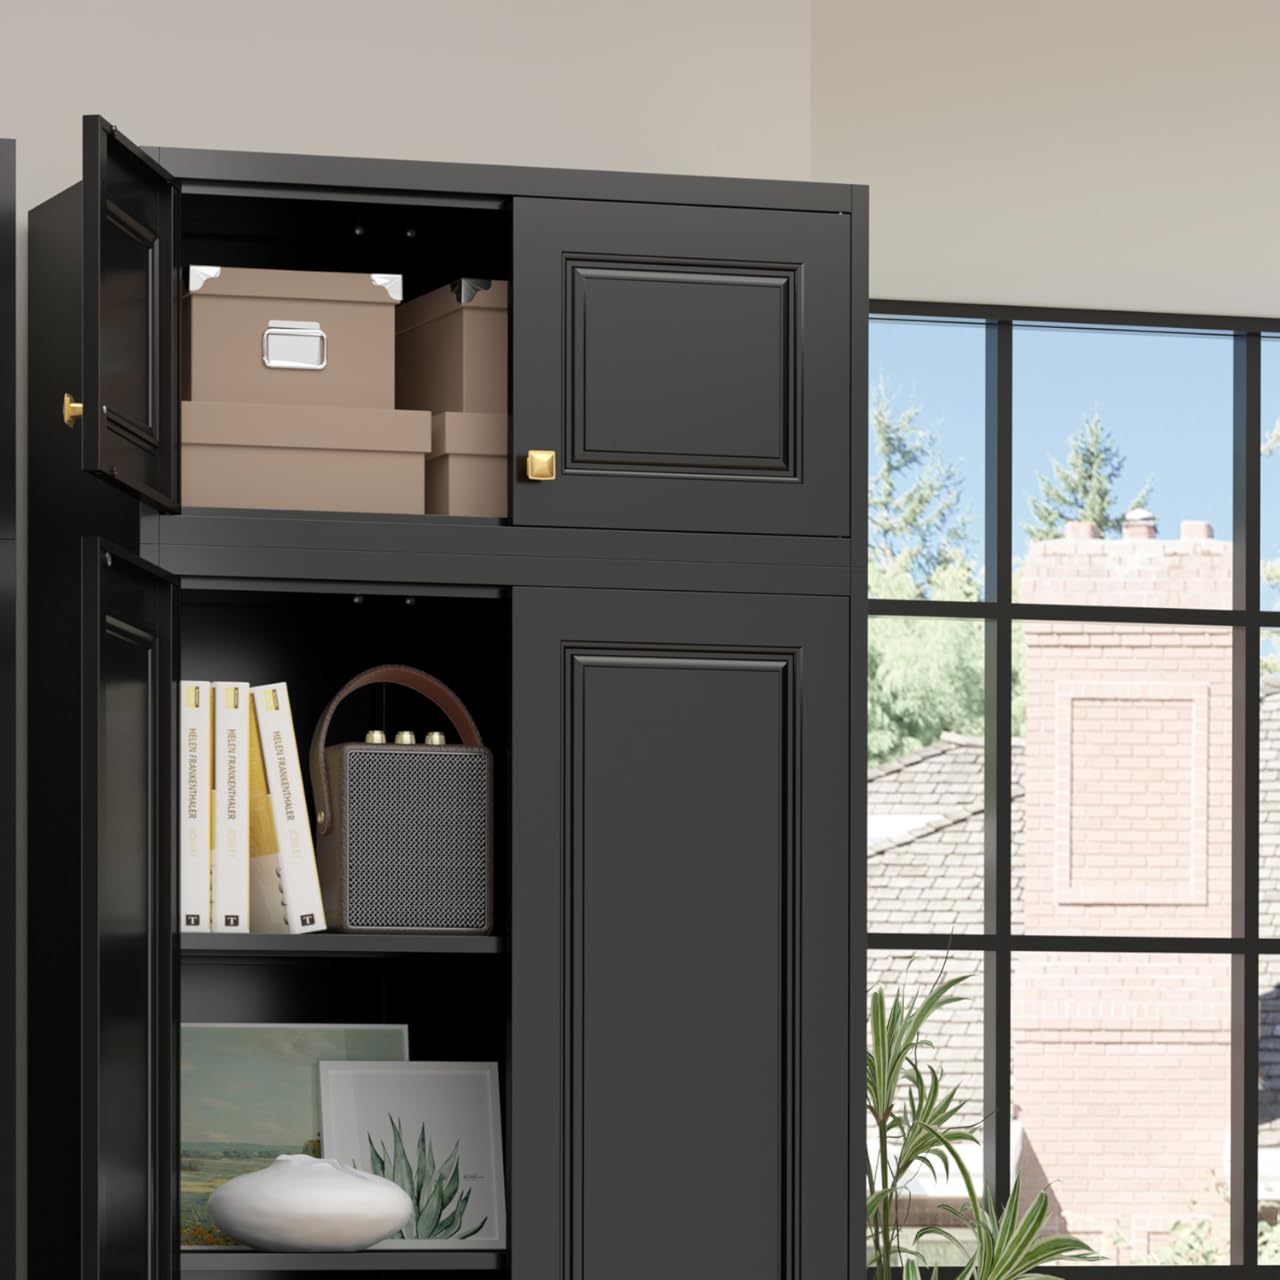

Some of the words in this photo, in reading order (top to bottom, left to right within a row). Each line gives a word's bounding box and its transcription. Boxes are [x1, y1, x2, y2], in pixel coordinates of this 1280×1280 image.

[188, 728, 197, 753] HELEN
[227, 729, 236, 754] HELEN
[272, 730, 285, 755] HELEN
[188, 754, 197, 819] FRANKENTHALER
[227, 755, 236, 820] FRANKENTHALER
[276, 757, 295, 821] FRANKENTHALER
